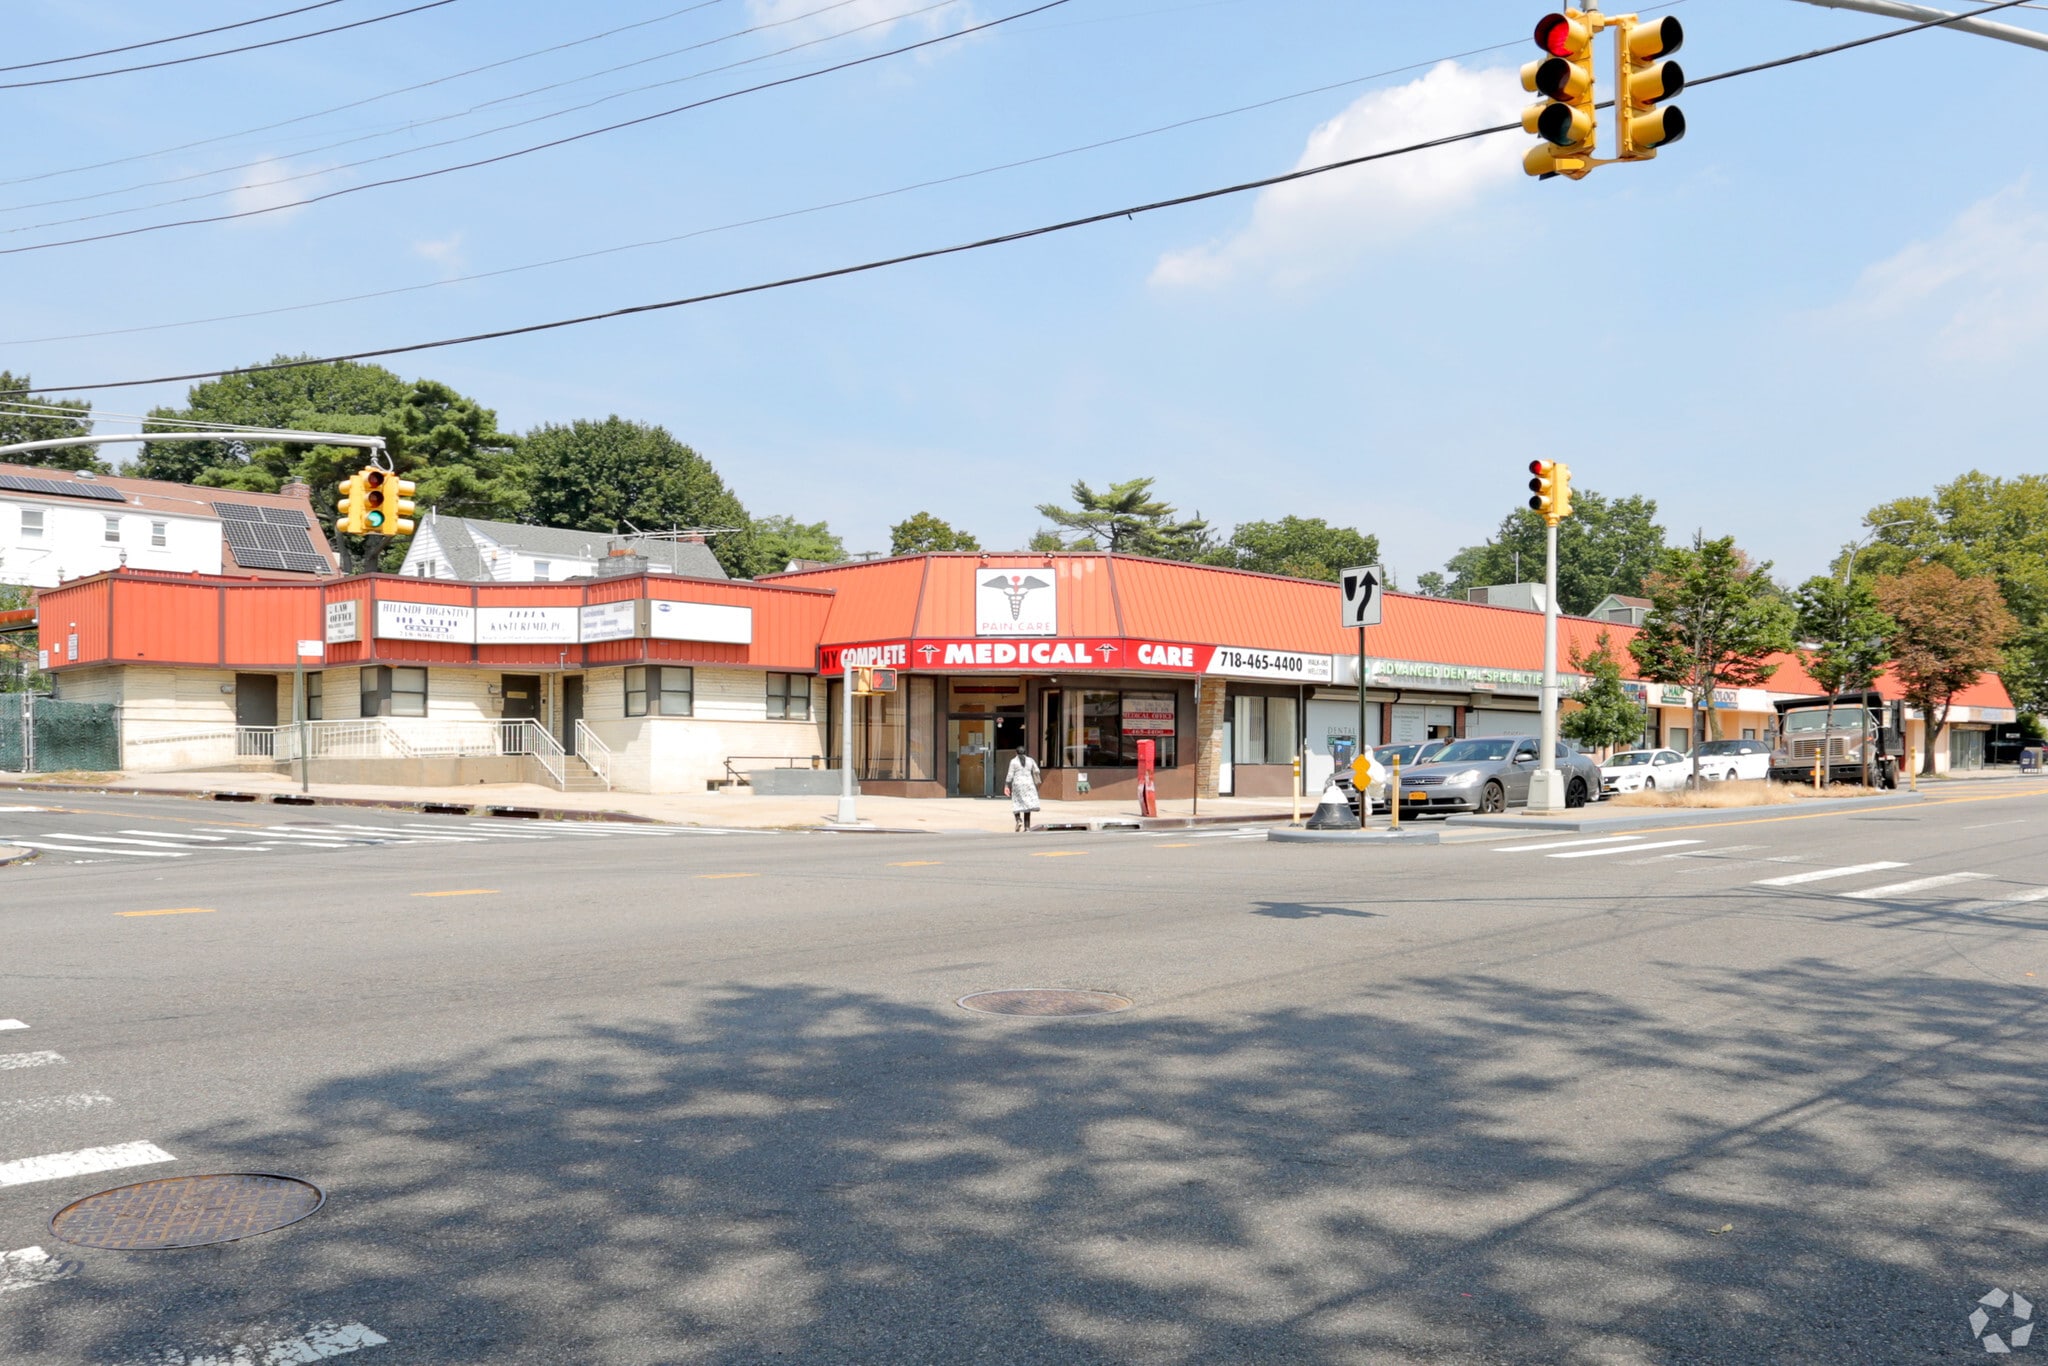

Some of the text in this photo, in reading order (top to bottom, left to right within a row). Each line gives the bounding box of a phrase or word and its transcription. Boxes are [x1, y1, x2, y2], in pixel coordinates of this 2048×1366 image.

[334, 604, 348, 613] LAW
[329, 613, 353, 623] OFFICE
[982, 622, 1051, 631] PAIN CARE
[822, 643, 1303, 673] NY COMPLETE MEDICAL CARE 718-465-4400
[1377, 662, 1440, 679] ADVANCED
[1443, 667, 1483, 682] DENTAL
[1486, 671, 1543, 686] SPECIALTIE
[1327, 726, 1356, 735] DENTAL
